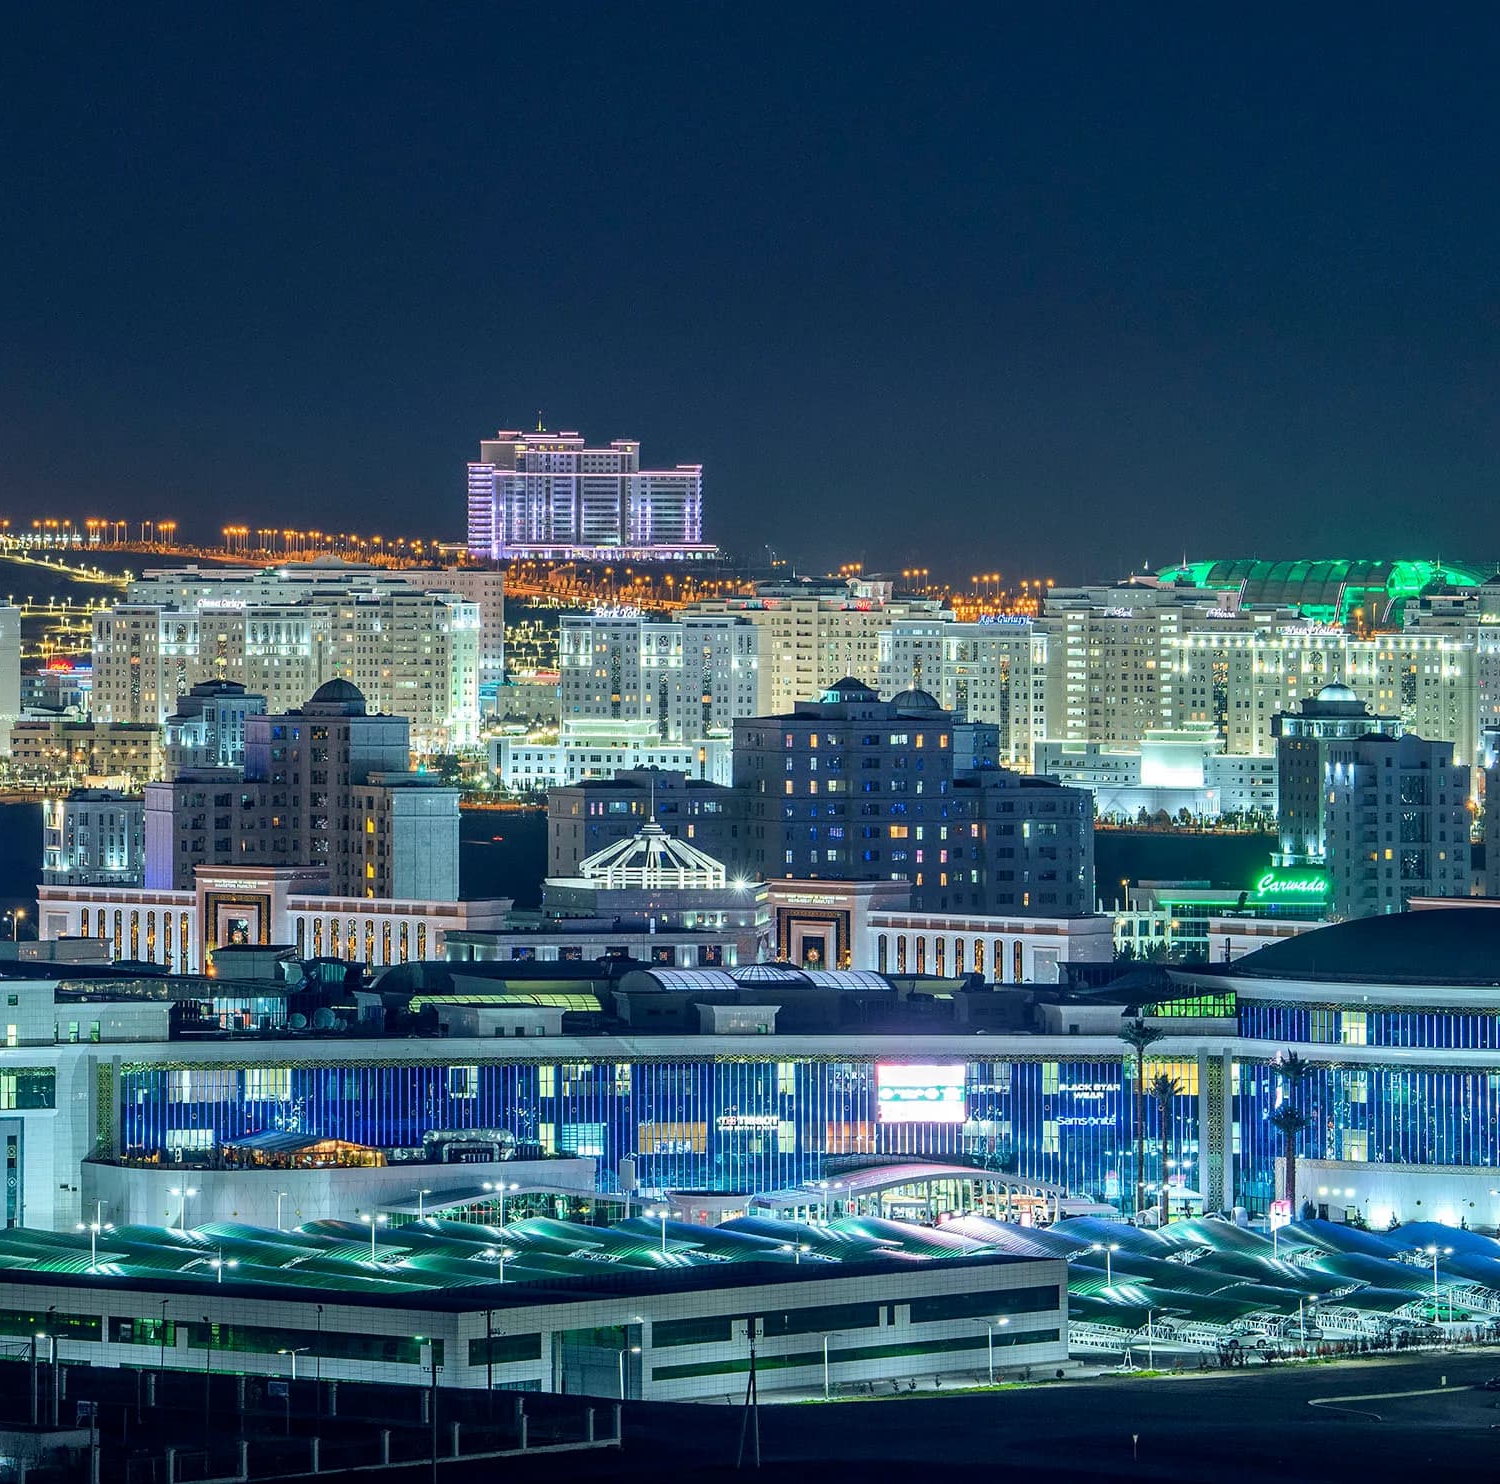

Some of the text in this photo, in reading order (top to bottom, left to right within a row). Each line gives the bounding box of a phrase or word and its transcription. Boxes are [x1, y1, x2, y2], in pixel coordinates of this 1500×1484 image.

[835, 1071, 866, 1080] ZARA
[1059, 1083, 1121, 1091] BLACK STAR
[1073, 1091, 1104, 1099] WEAR
[736, 1115, 779, 1126] TISSOT
